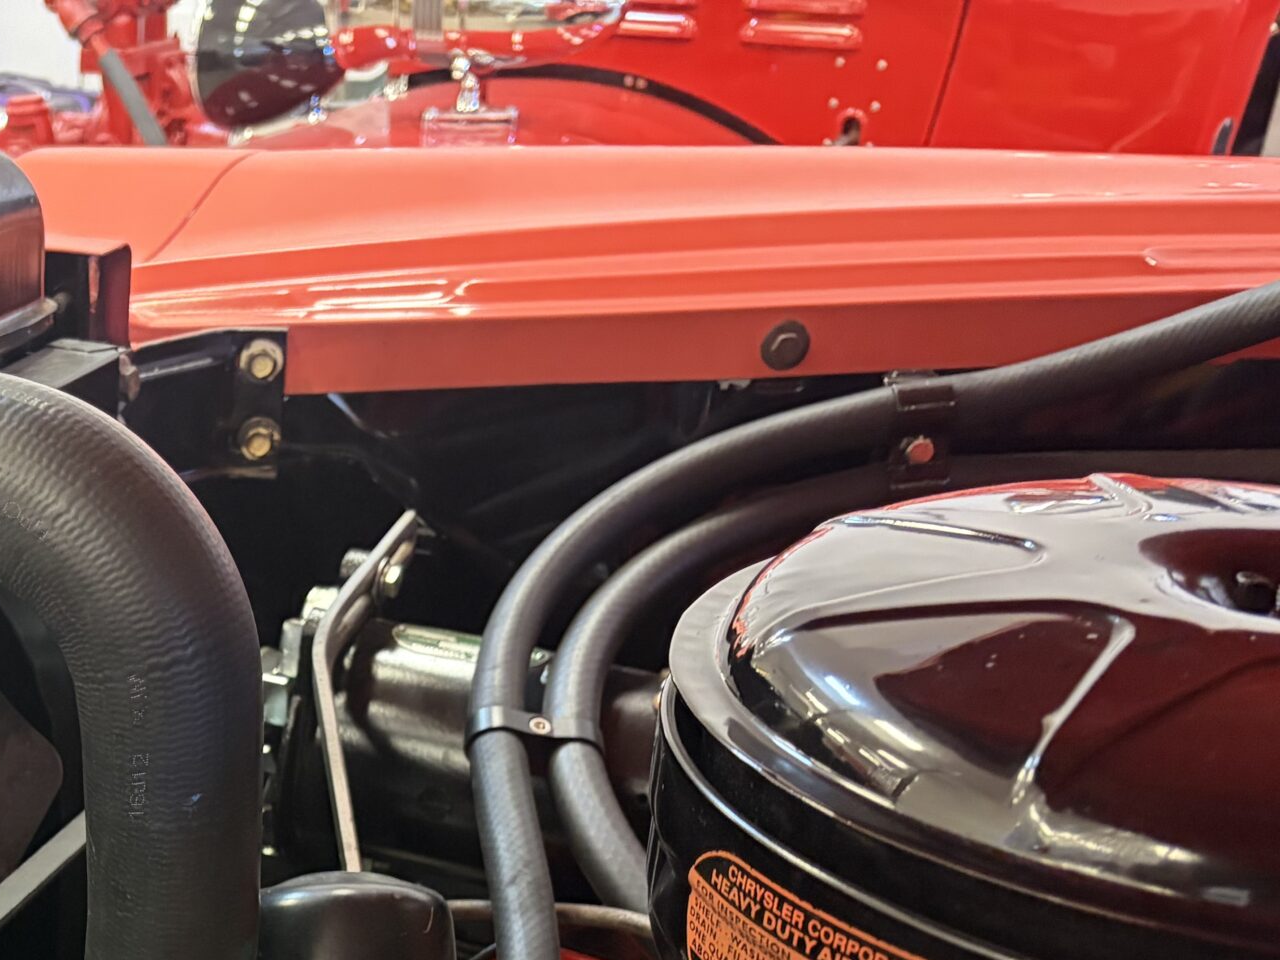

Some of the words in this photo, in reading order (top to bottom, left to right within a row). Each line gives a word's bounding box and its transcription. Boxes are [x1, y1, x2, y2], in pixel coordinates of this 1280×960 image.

[696, 879, 714, 900] FOR
[711, 868, 760, 919] HEAVY
[762, 910, 817, 955] DUTY
[728, 864, 805, 930] CHRYSLER
[689, 921, 706, 945] ONE
